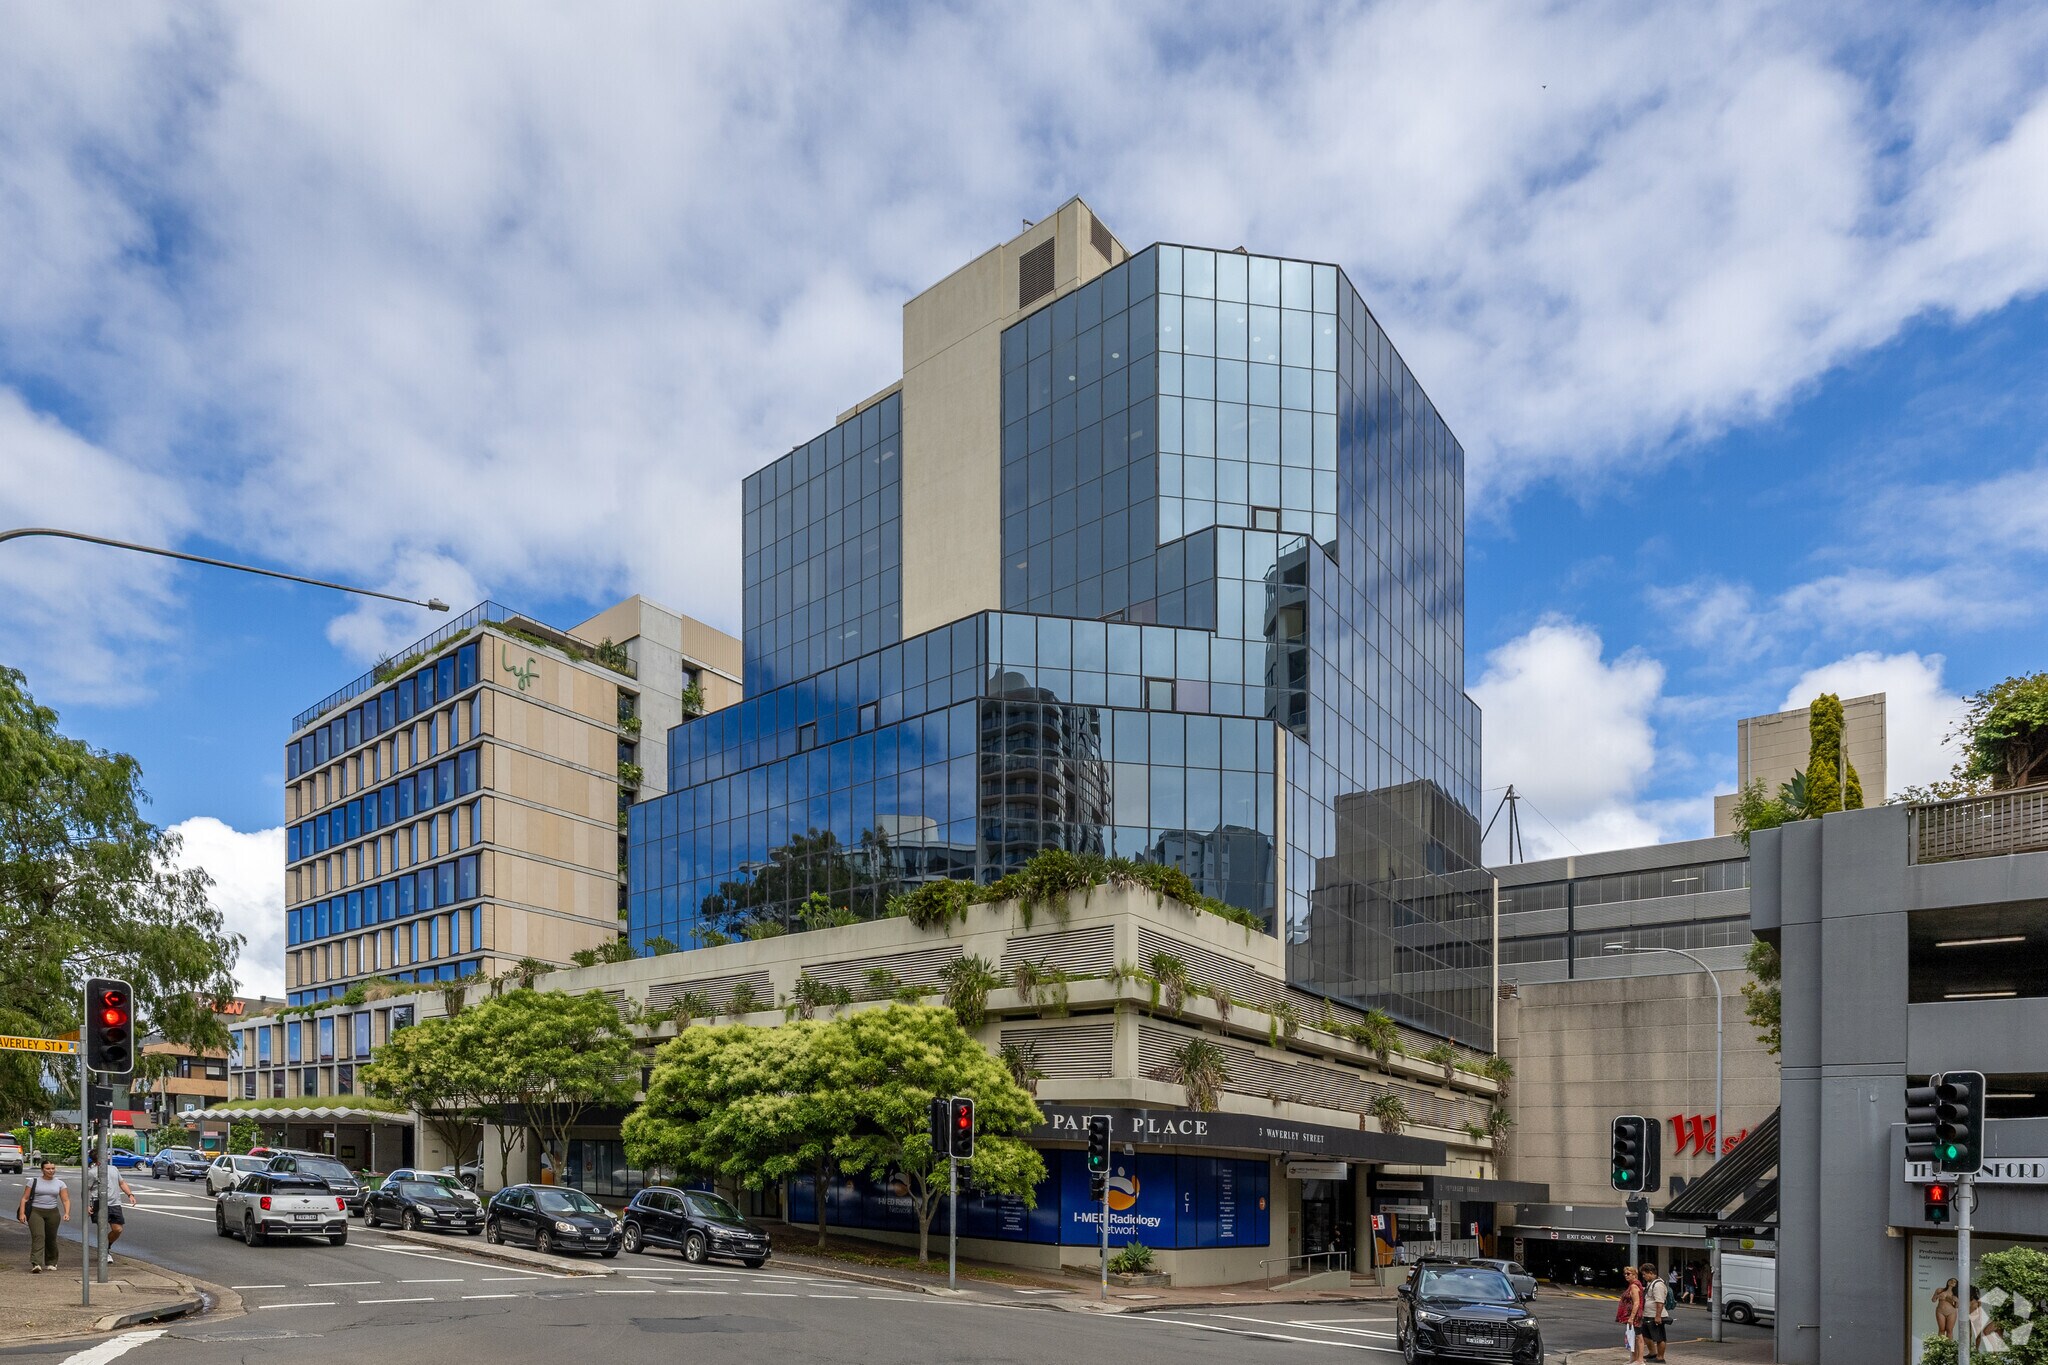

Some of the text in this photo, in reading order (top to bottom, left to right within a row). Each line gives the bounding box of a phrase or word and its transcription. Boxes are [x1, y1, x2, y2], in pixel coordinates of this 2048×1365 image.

[502, 644, 540, 690] lyf
[45, 1041, 57, 1051] ST
[1132, 1117, 1208, 1135] PLACE
[1258, 1127, 1325, 1144] 3 WAVERLEY STREET
[1667, 1114, 1748, 1157] West
[1109, 1213, 1161, 1227] Radiology
